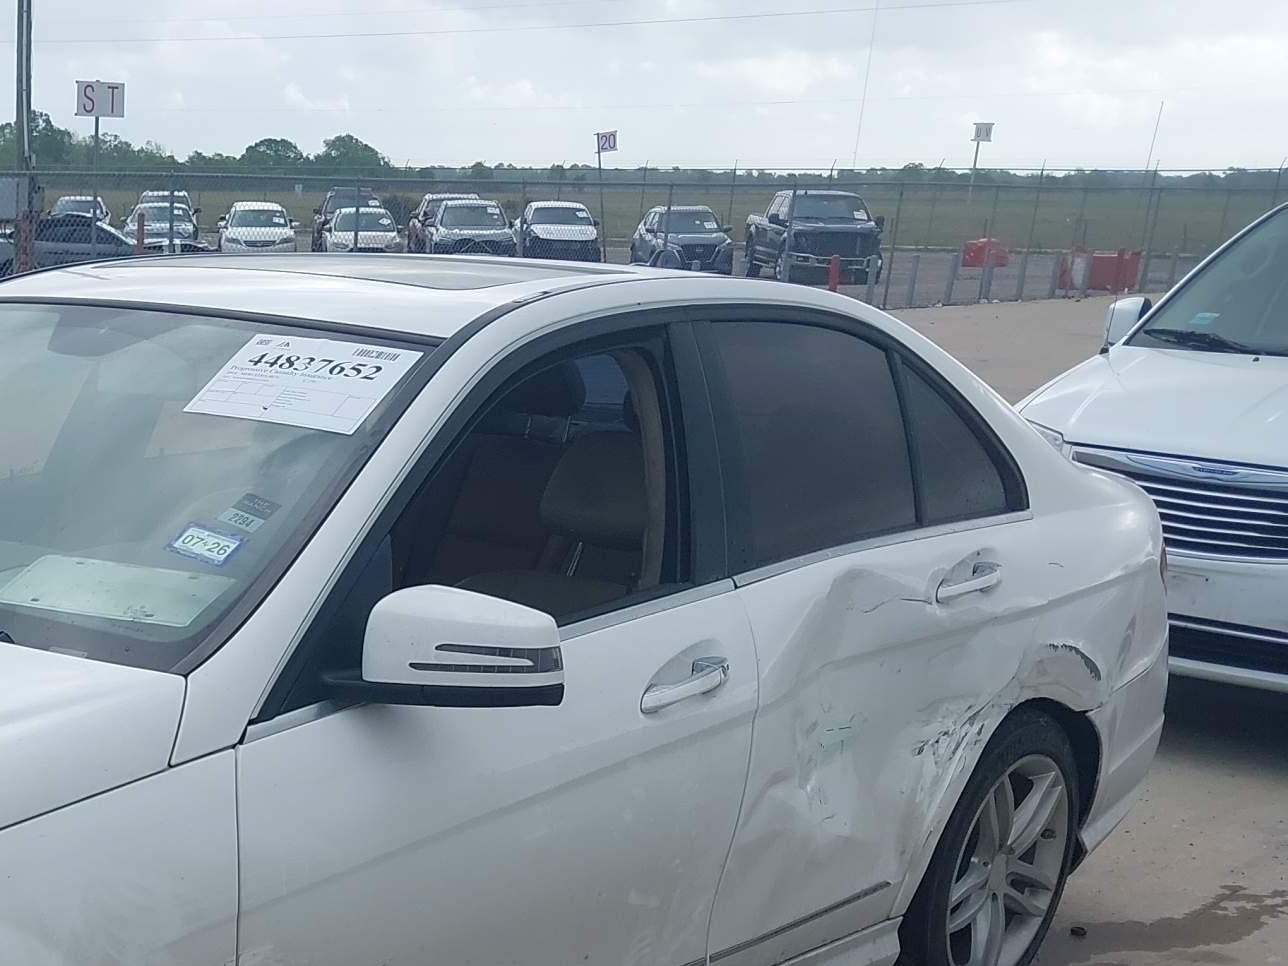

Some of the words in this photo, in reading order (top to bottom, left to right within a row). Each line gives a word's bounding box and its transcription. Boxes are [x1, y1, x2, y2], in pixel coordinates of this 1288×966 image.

[83, 84, 95, 113] S
[107, 86, 119, 114] T
[600, 133, 616, 150] 20
[247, 352, 385, 381] 44837652
